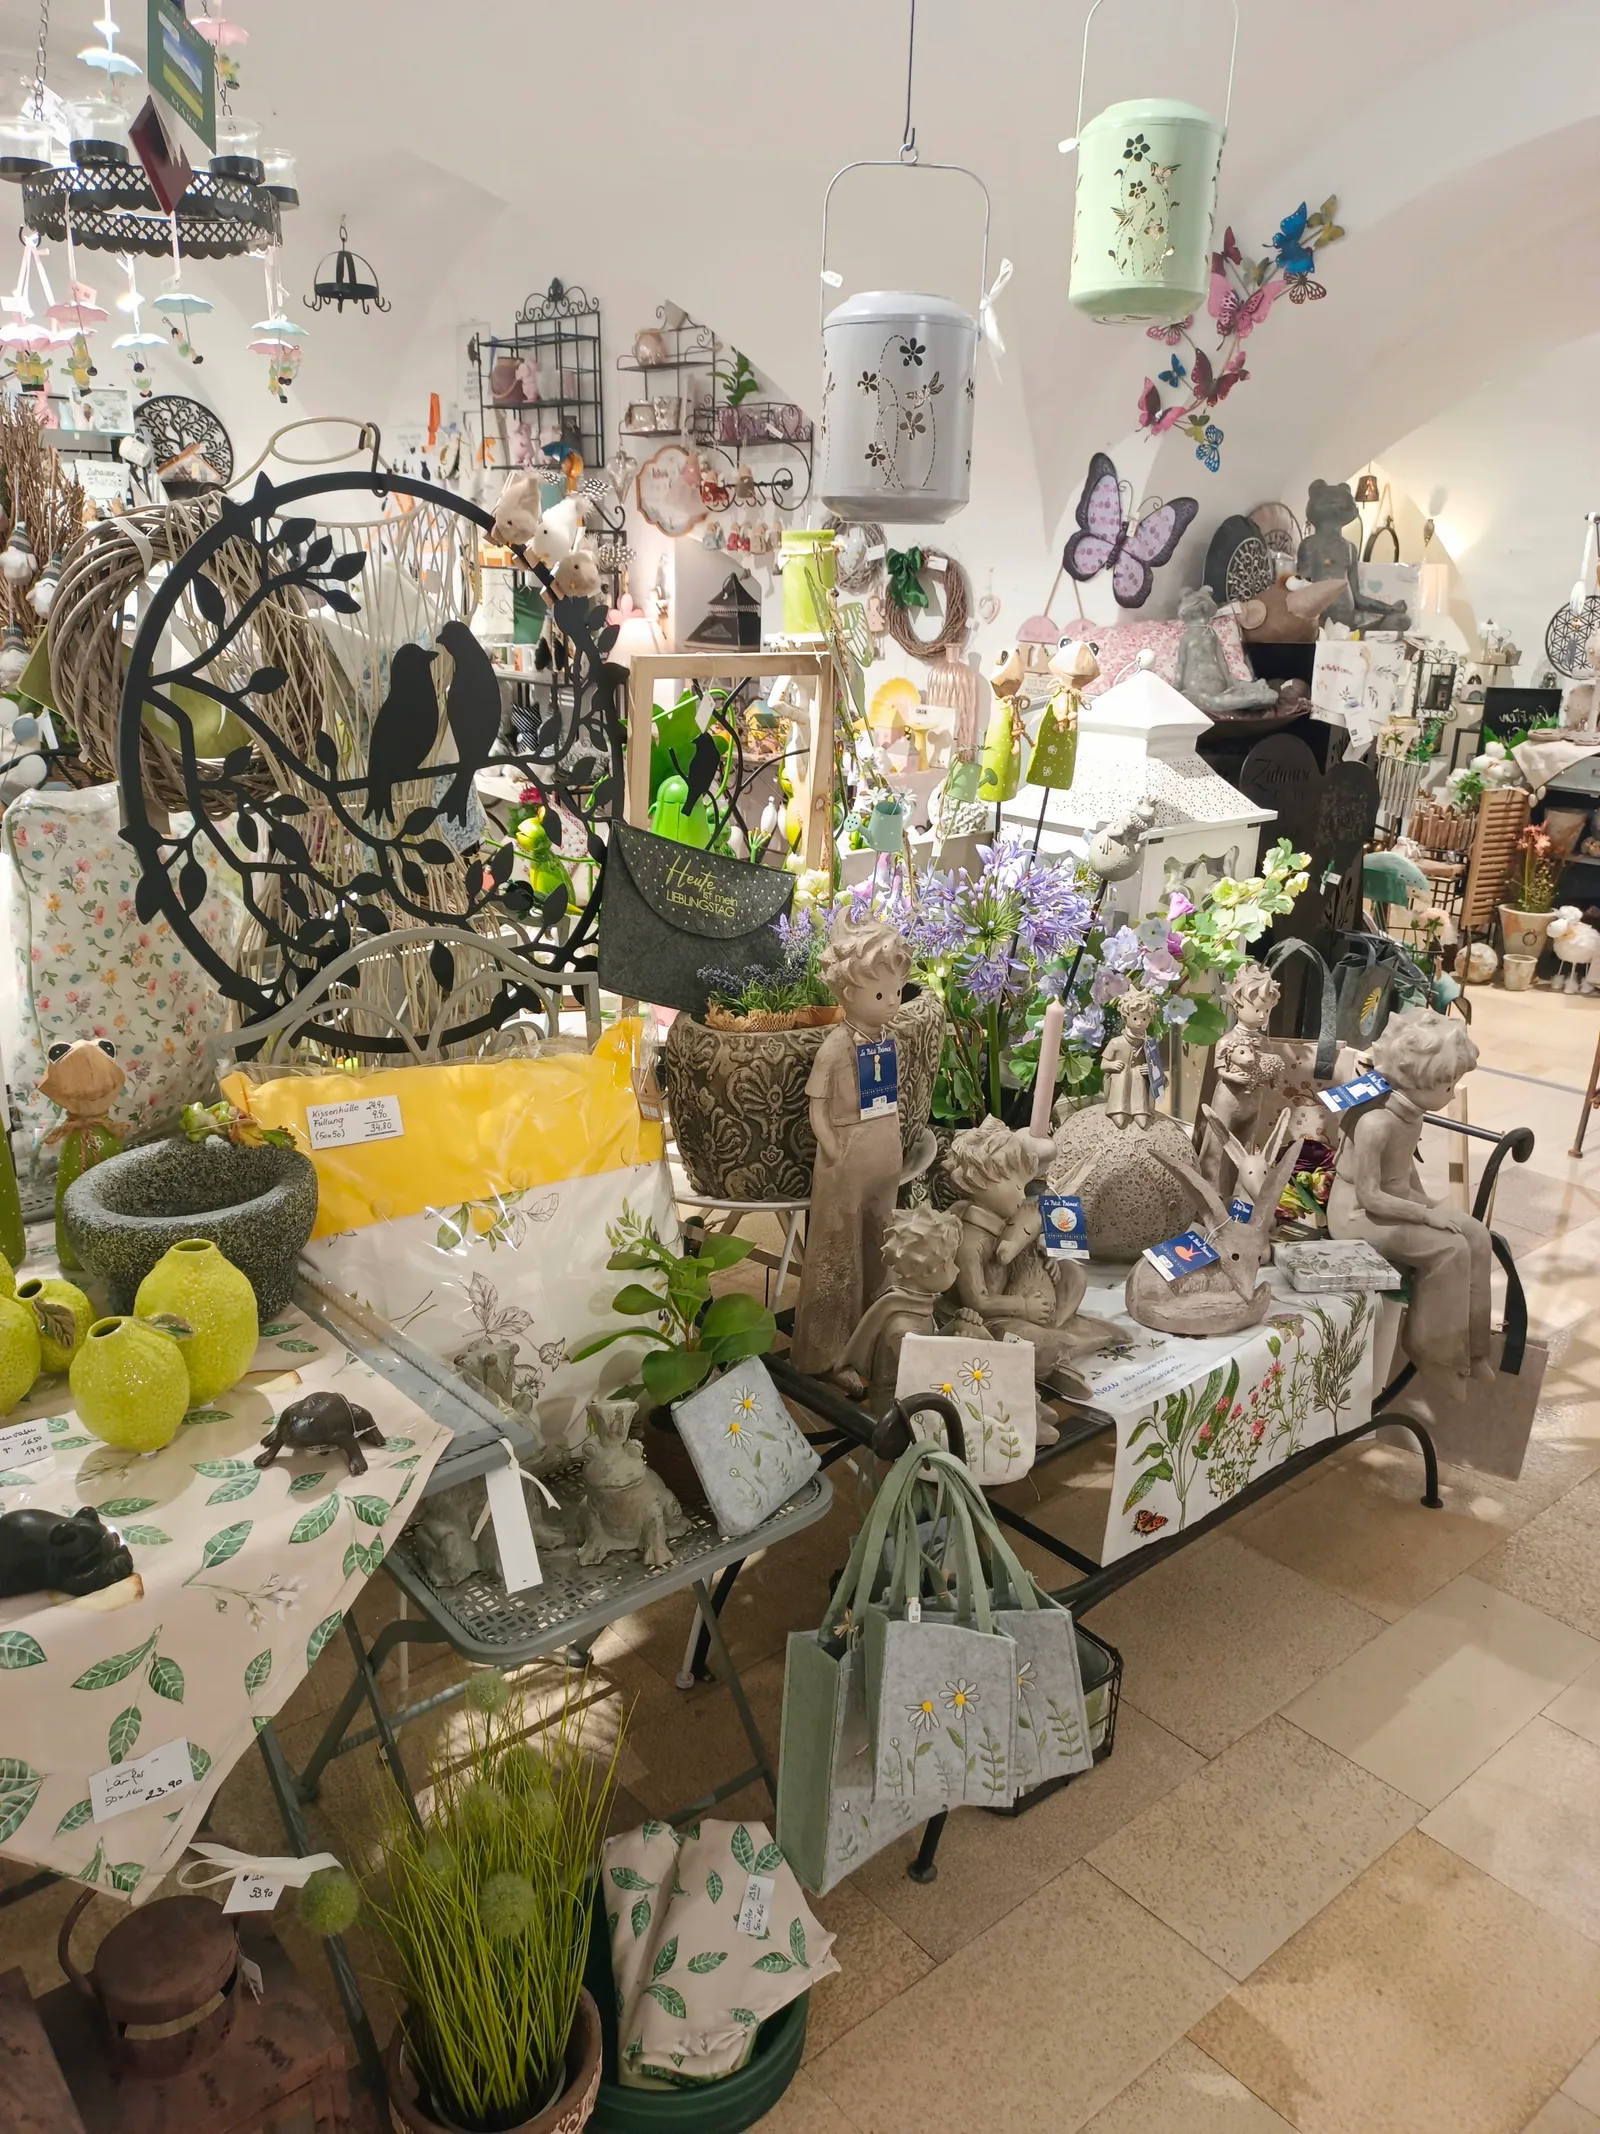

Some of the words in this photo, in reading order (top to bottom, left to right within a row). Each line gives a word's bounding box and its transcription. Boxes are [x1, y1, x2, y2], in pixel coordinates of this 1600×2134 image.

[666, 855, 718, 892] Heute
[666, 890, 736, 918] LIEBLINGSTAG
[702, 888, 712, 900] ist
[714, 893, 738, 907] mein
[312, 1103, 360, 1118] Kissenhülle
[372, 1109, 387, 1119] 9.90
[370, 1121, 392, 1133] 34.80
[145, 1779, 183, 1801] 23.90
[250, 1887, 273, 1898] 53.90
